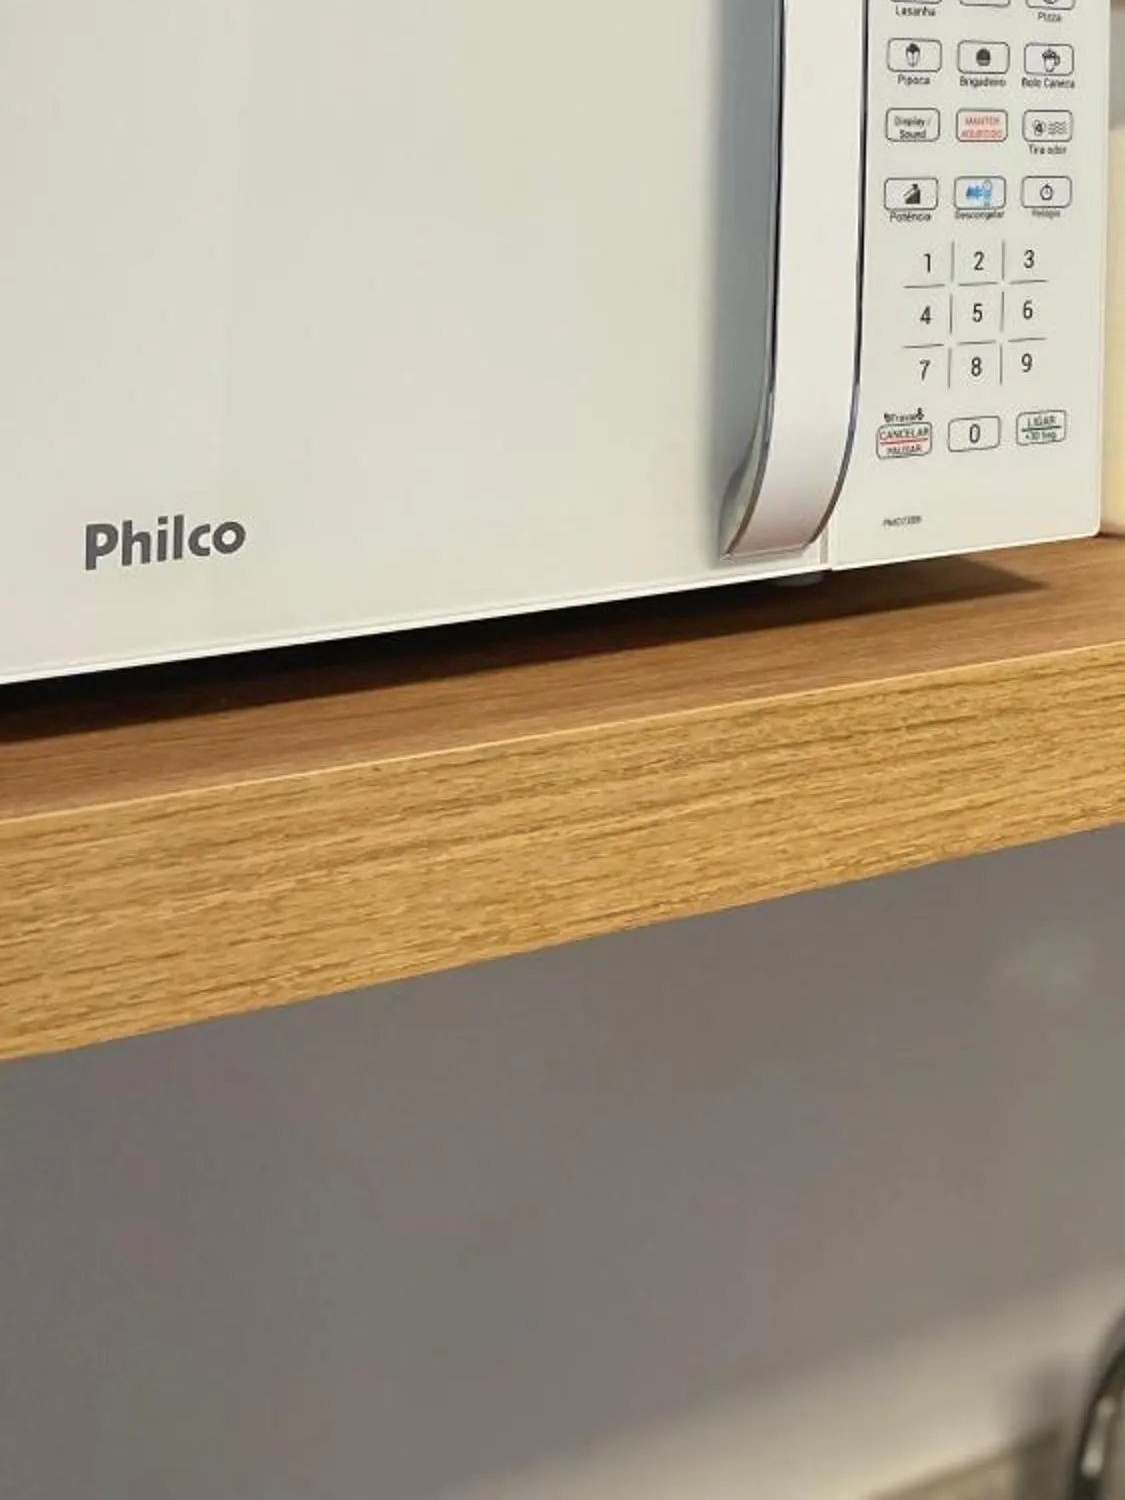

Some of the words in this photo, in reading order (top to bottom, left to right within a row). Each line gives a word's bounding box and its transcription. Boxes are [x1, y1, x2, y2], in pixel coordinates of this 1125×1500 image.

[895, 6, 936, 17] Lasanha
[897, 74, 930, 86] Pipoca
[959, 76, 1006, 88] Brigadeiro
[900, 129, 926, 139] Sound
[923, 253, 932, 273] 1
[973, 251, 985, 271] 2
[1023, 249, 1035, 269] 3
[919, 305, 931, 325] 4
[972, 303, 983, 322] 5
[1022, 300, 1033, 320] 6
[919, 359, 931, 381] 7
[970, 357, 982, 377] 8
[1021, 353, 1033, 373] 9
[969, 424, 981, 443] 0
[85, 514, 246, 571] Philco
